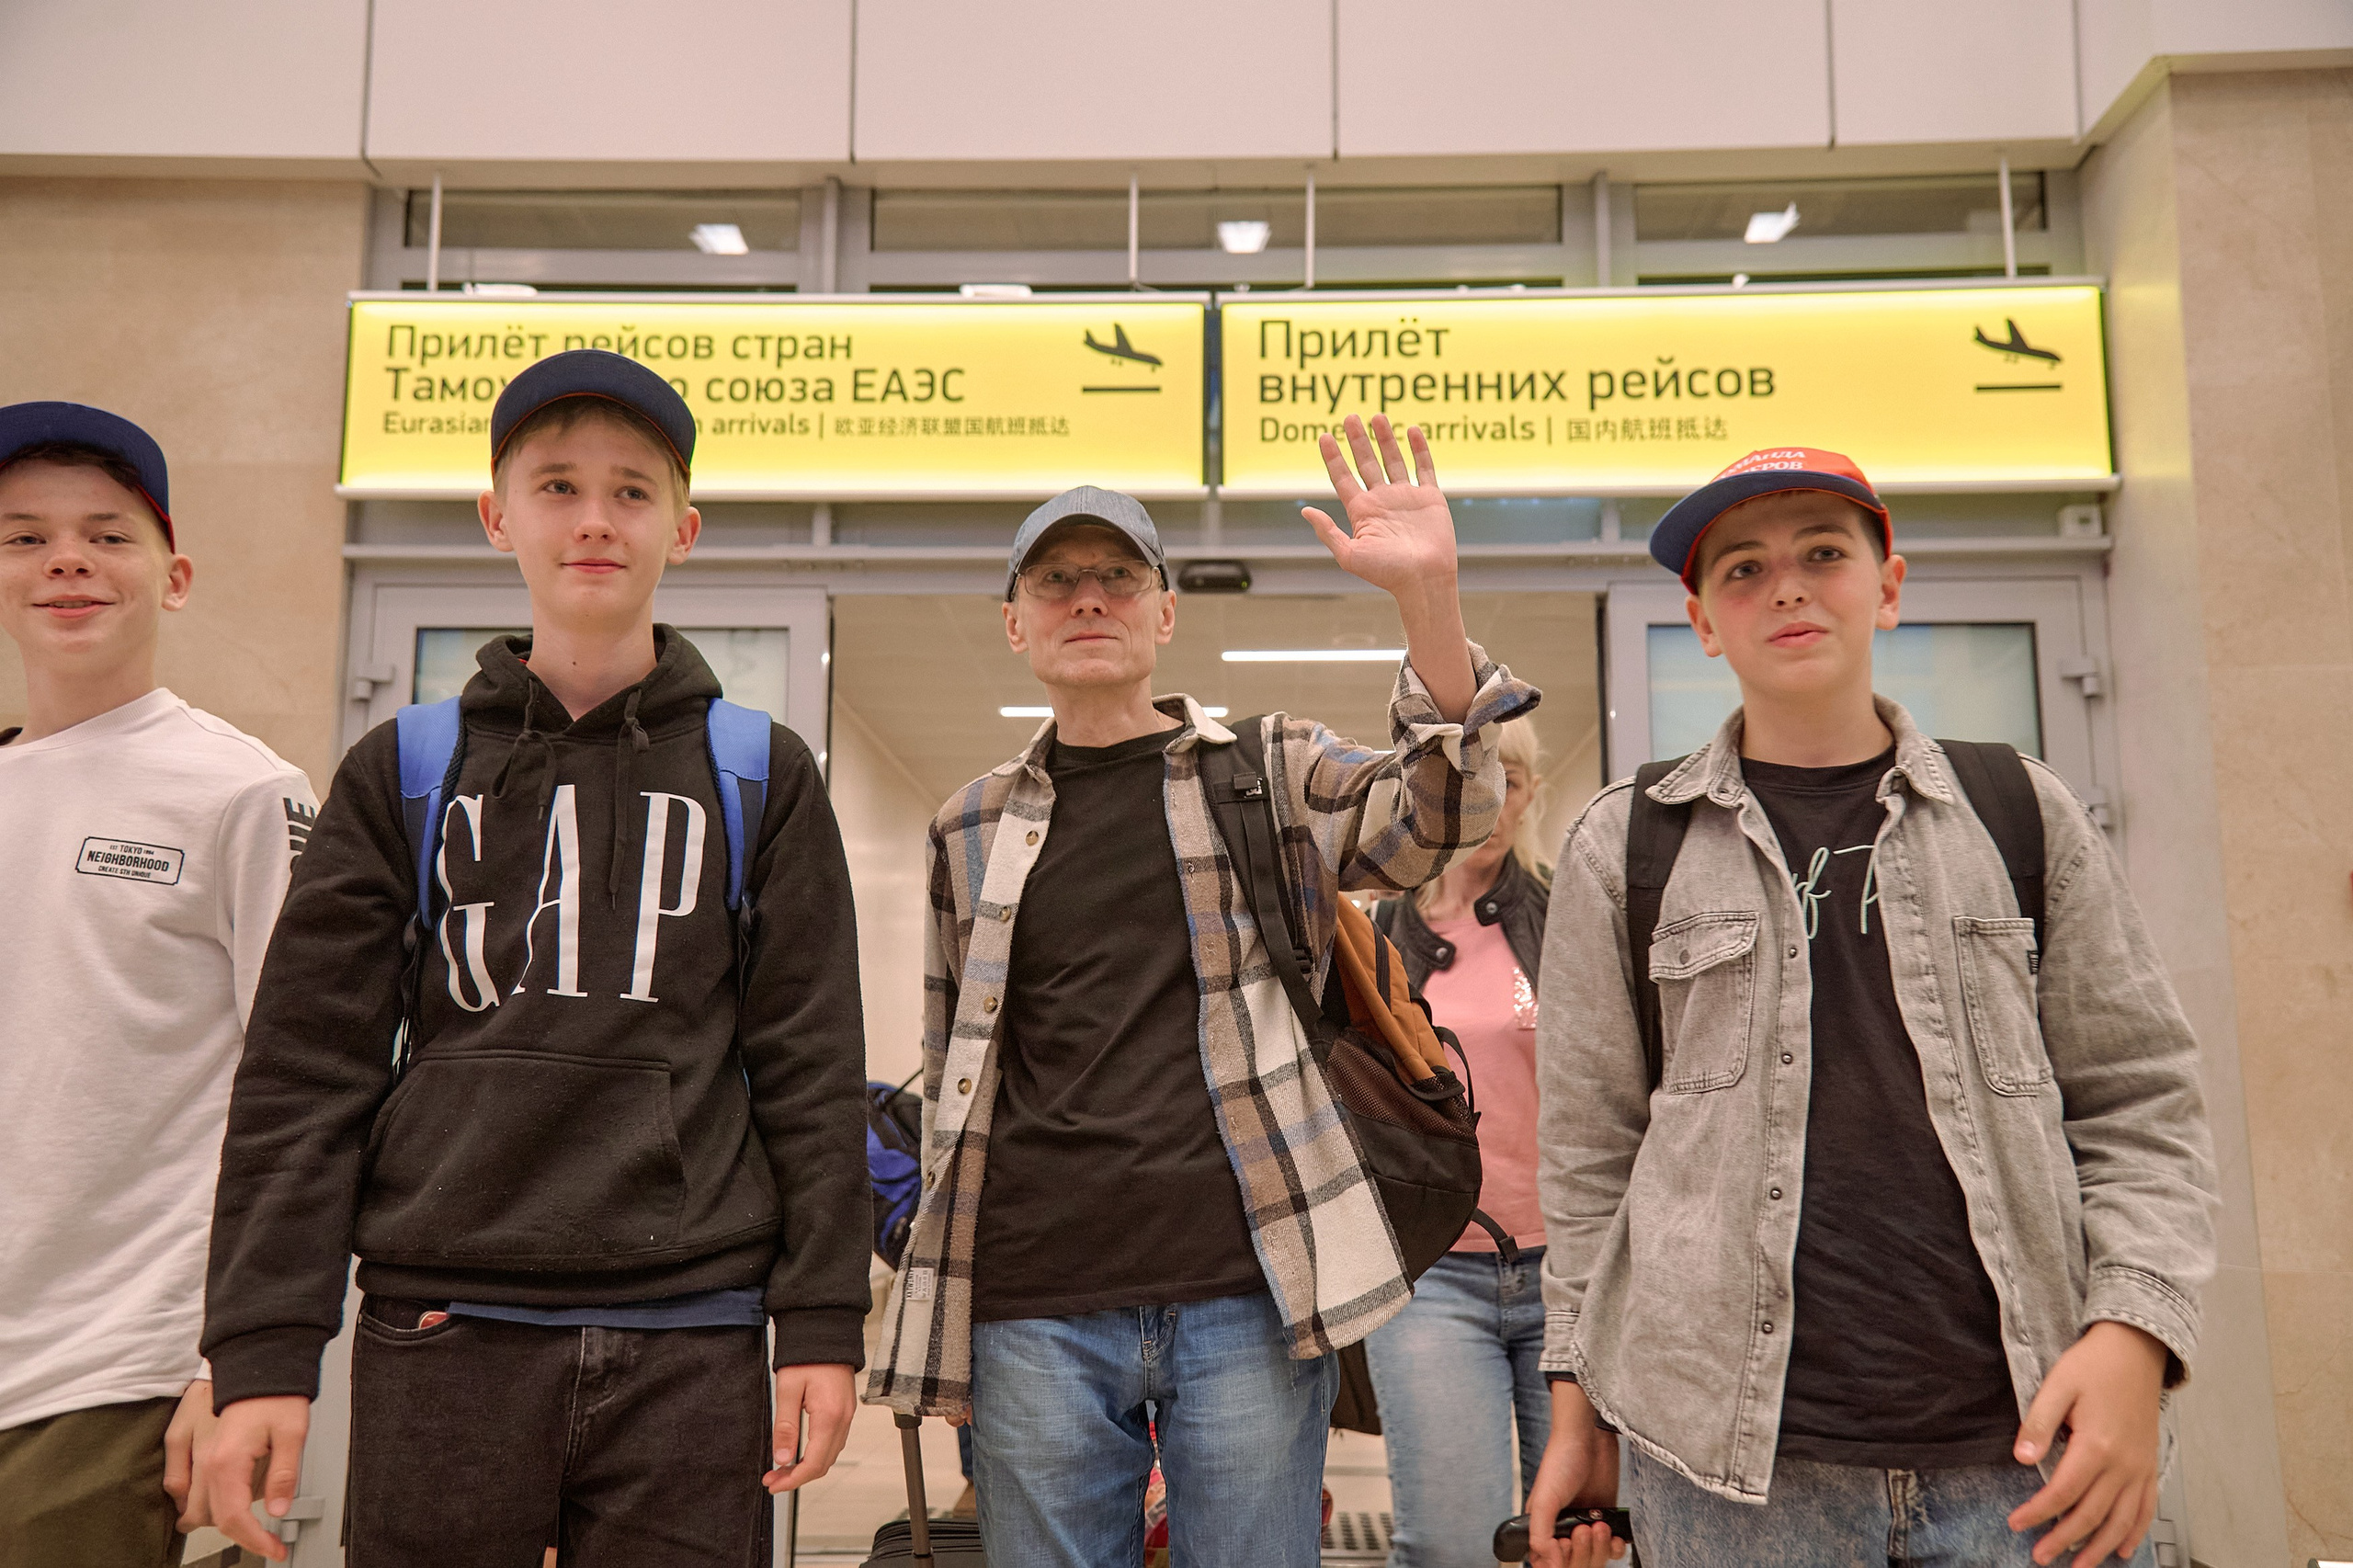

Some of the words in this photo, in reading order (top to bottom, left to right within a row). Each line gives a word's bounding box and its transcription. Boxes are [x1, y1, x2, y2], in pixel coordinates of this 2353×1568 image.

[388, 324, 549, 367] Прилёт
[733, 334, 852, 368] стран
[1260, 318, 1449, 368] Прилёт
[706, 377, 835, 403] союза
[852, 368, 965, 403] ЕАЭС
[1260, 369, 1568, 413] внутренних
[1588, 357, 1776, 410] рейсов
[712, 413, 810, 435] arrivals
[1418, 415, 1535, 441] arrivals
[1567, 416, 1726, 441] 国内航班抵达
[87, 850, 169, 871] NEIGHBORHOOD
[119, 845, 142, 855] TOKYO
[98, 865, 119, 874] CREATE
[131, 870, 151, 879] UNIQUE
[437, 784, 707, 1012] GAP
